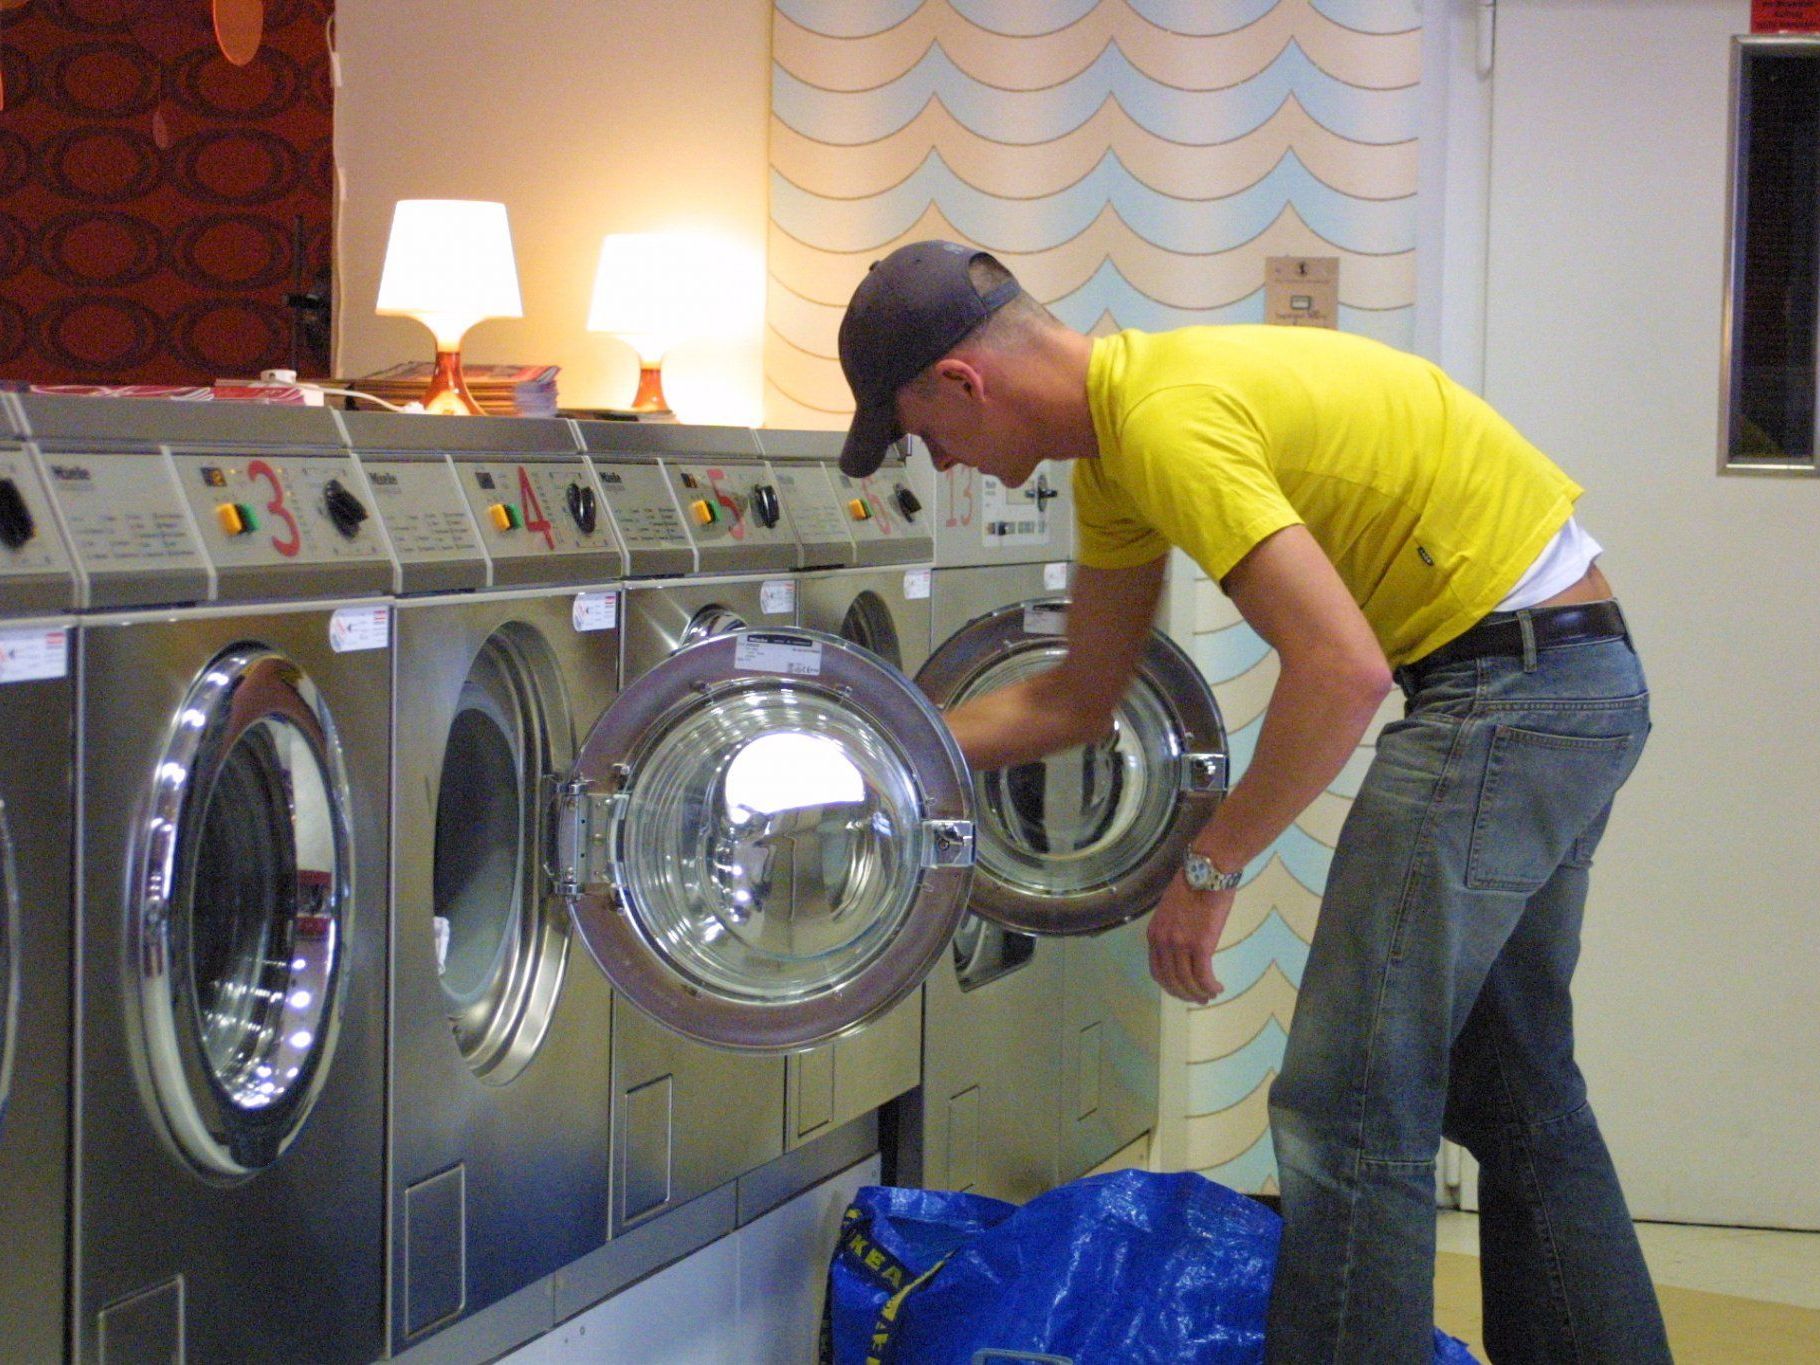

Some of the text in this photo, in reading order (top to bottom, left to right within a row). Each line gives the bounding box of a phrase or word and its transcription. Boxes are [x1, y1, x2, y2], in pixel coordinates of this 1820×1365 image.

[248, 460, 300, 557] 3
[518, 465, 555, 550] 4
[706, 468, 746, 540] 5
[945, 464, 974, 528] 13
